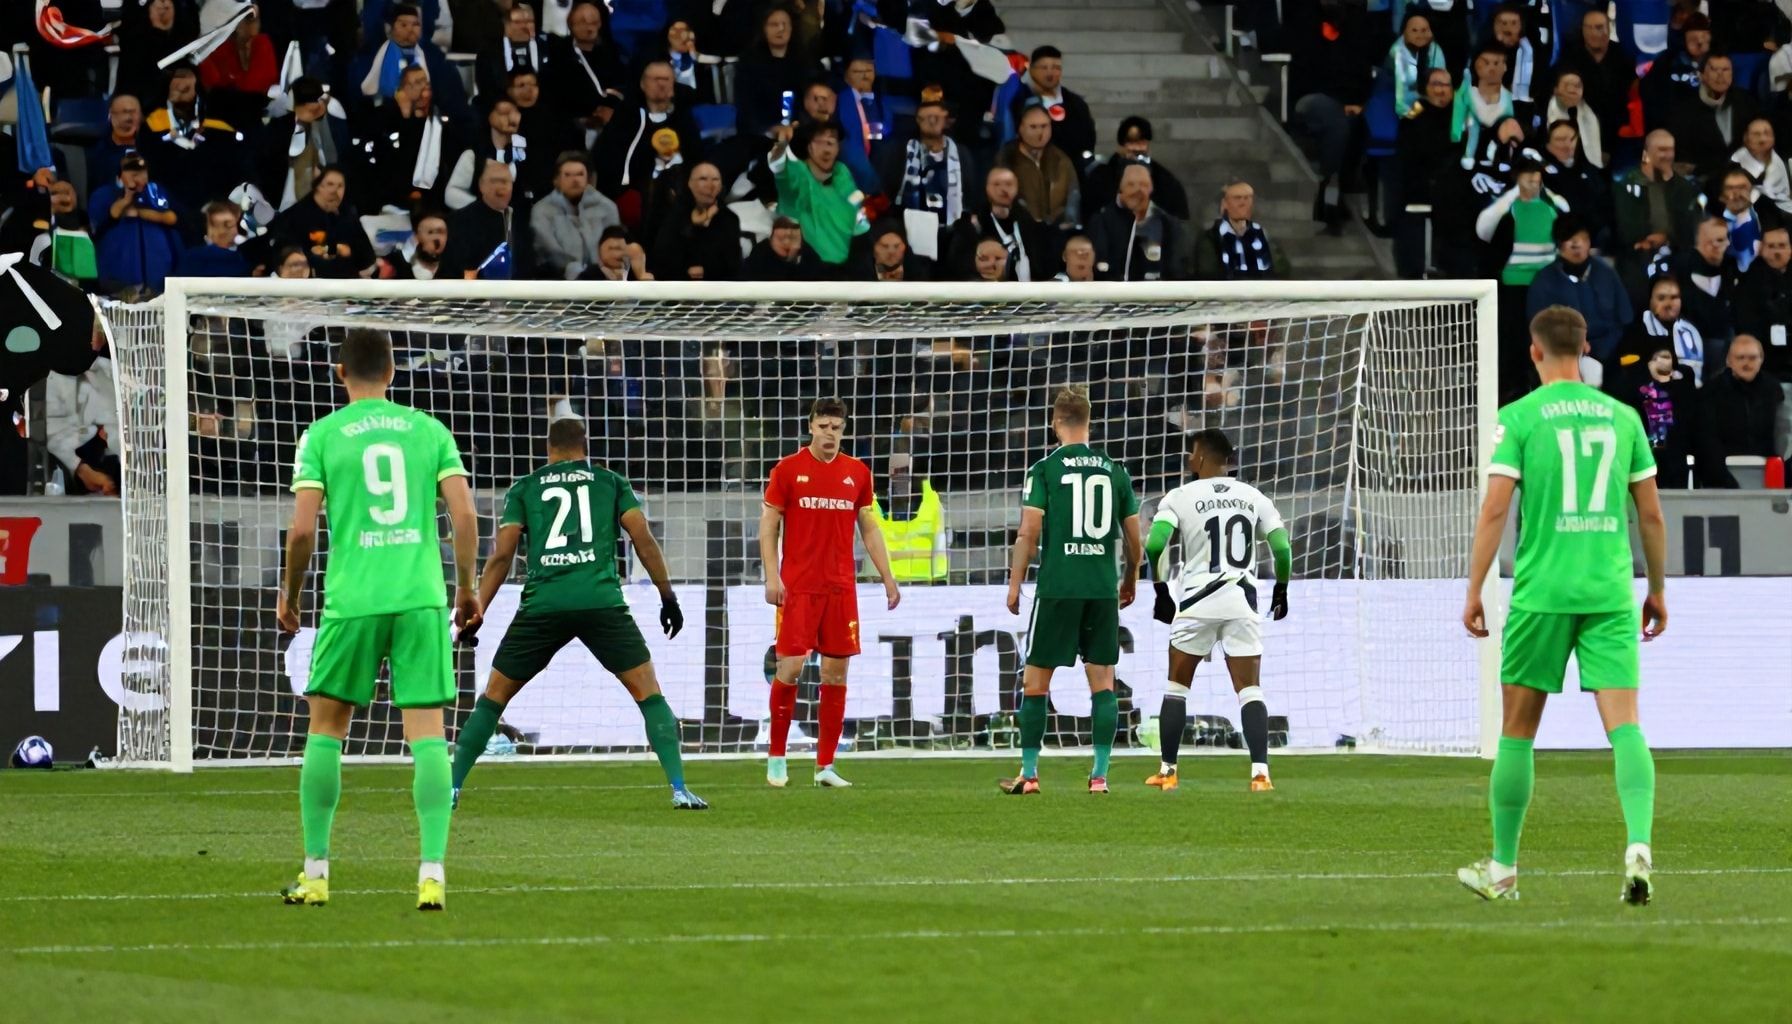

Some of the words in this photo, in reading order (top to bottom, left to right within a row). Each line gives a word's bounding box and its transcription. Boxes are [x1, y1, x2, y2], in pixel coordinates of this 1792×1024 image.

[362, 443, 408, 526] 9
[1555, 425, 1616, 514] 17
[541, 484, 593, 550] 21
[1061, 473, 1113, 540] 10
[1204, 514, 1253, 574] 10
